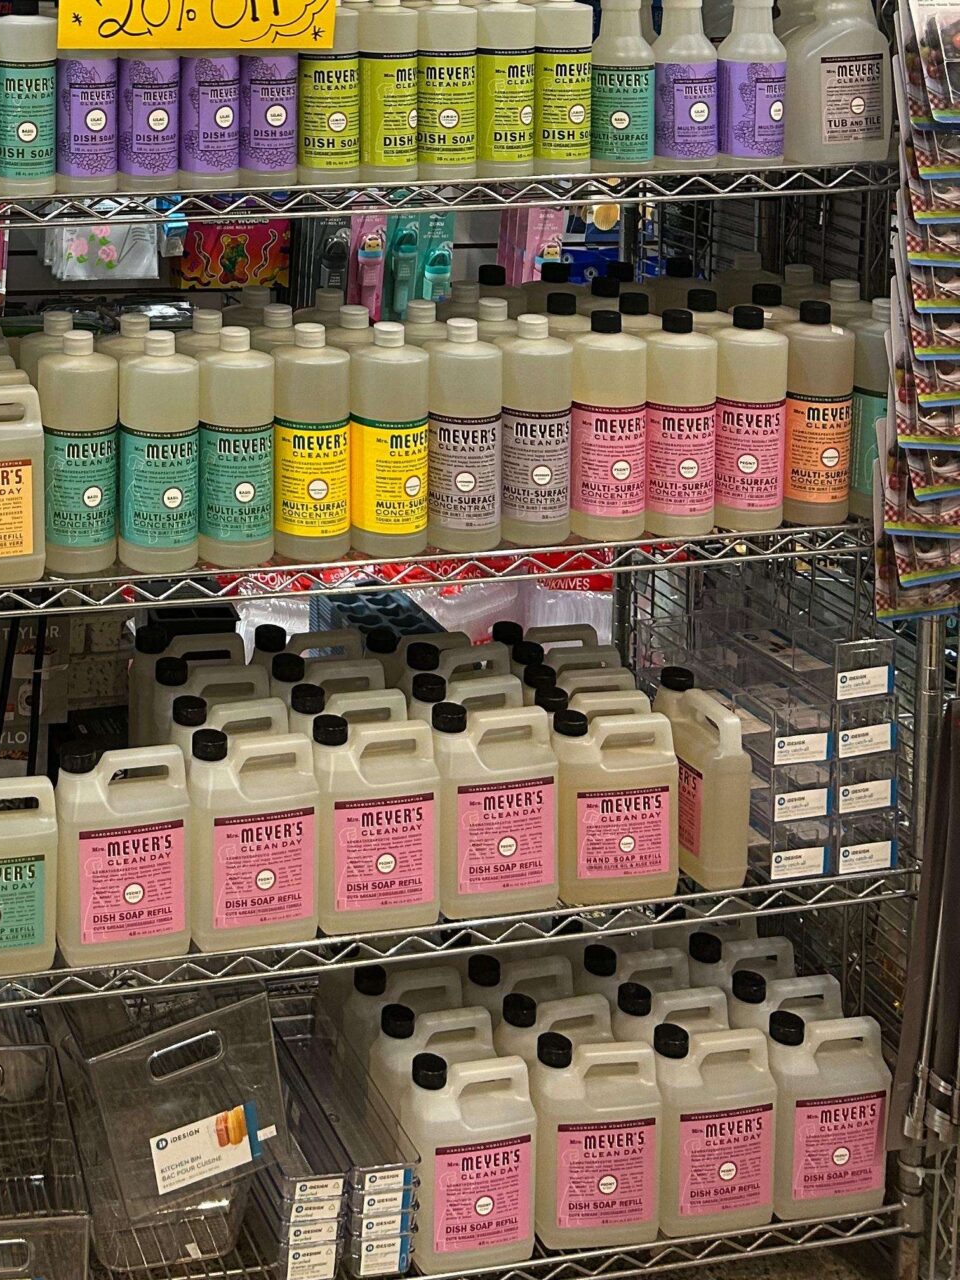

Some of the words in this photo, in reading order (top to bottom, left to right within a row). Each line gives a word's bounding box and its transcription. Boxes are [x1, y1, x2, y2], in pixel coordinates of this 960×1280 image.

[426, 65, 476, 80] MEYER'S
[827, 119, 848, 128] TUB
[864, 116, 881, 126] TILE
[722, 409, 781, 429] MEYER'S
[282, 498, 348, 512] MULTI-SURFACE
[429, 491, 495, 505] MULTI-SURFACE
[483, 790, 543, 810] MEYER'S
[107, 834, 172, 857] MEYER'S
[586, 856, 610, 864] HAND
[614, 855, 635, 863] SOAP
[639, 853, 661, 861] REFILL
[93, 914, 115, 923] DISH
[118, 910, 144, 921] SOAP
[147, 907, 172, 916] REFILL
[820, 1104, 876, 1123] MEYER'S
[170, 1128, 200, 1144] iDESIGN
[160, 1157, 190, 1174] KITCHEN
[190, 1154, 202, 1164] BIN
[161, 1172, 176, 1182] BAC
[176, 1166, 195, 1177] POUR
[196, 1154, 222, 1169] CUISINE
[461, 1149, 520, 1172] MEYER'S
[445, 1225, 467, 1234] DISH
[470, 1222, 493, 1232] SOAP
[496, 1217, 518, 1227] REFILL
